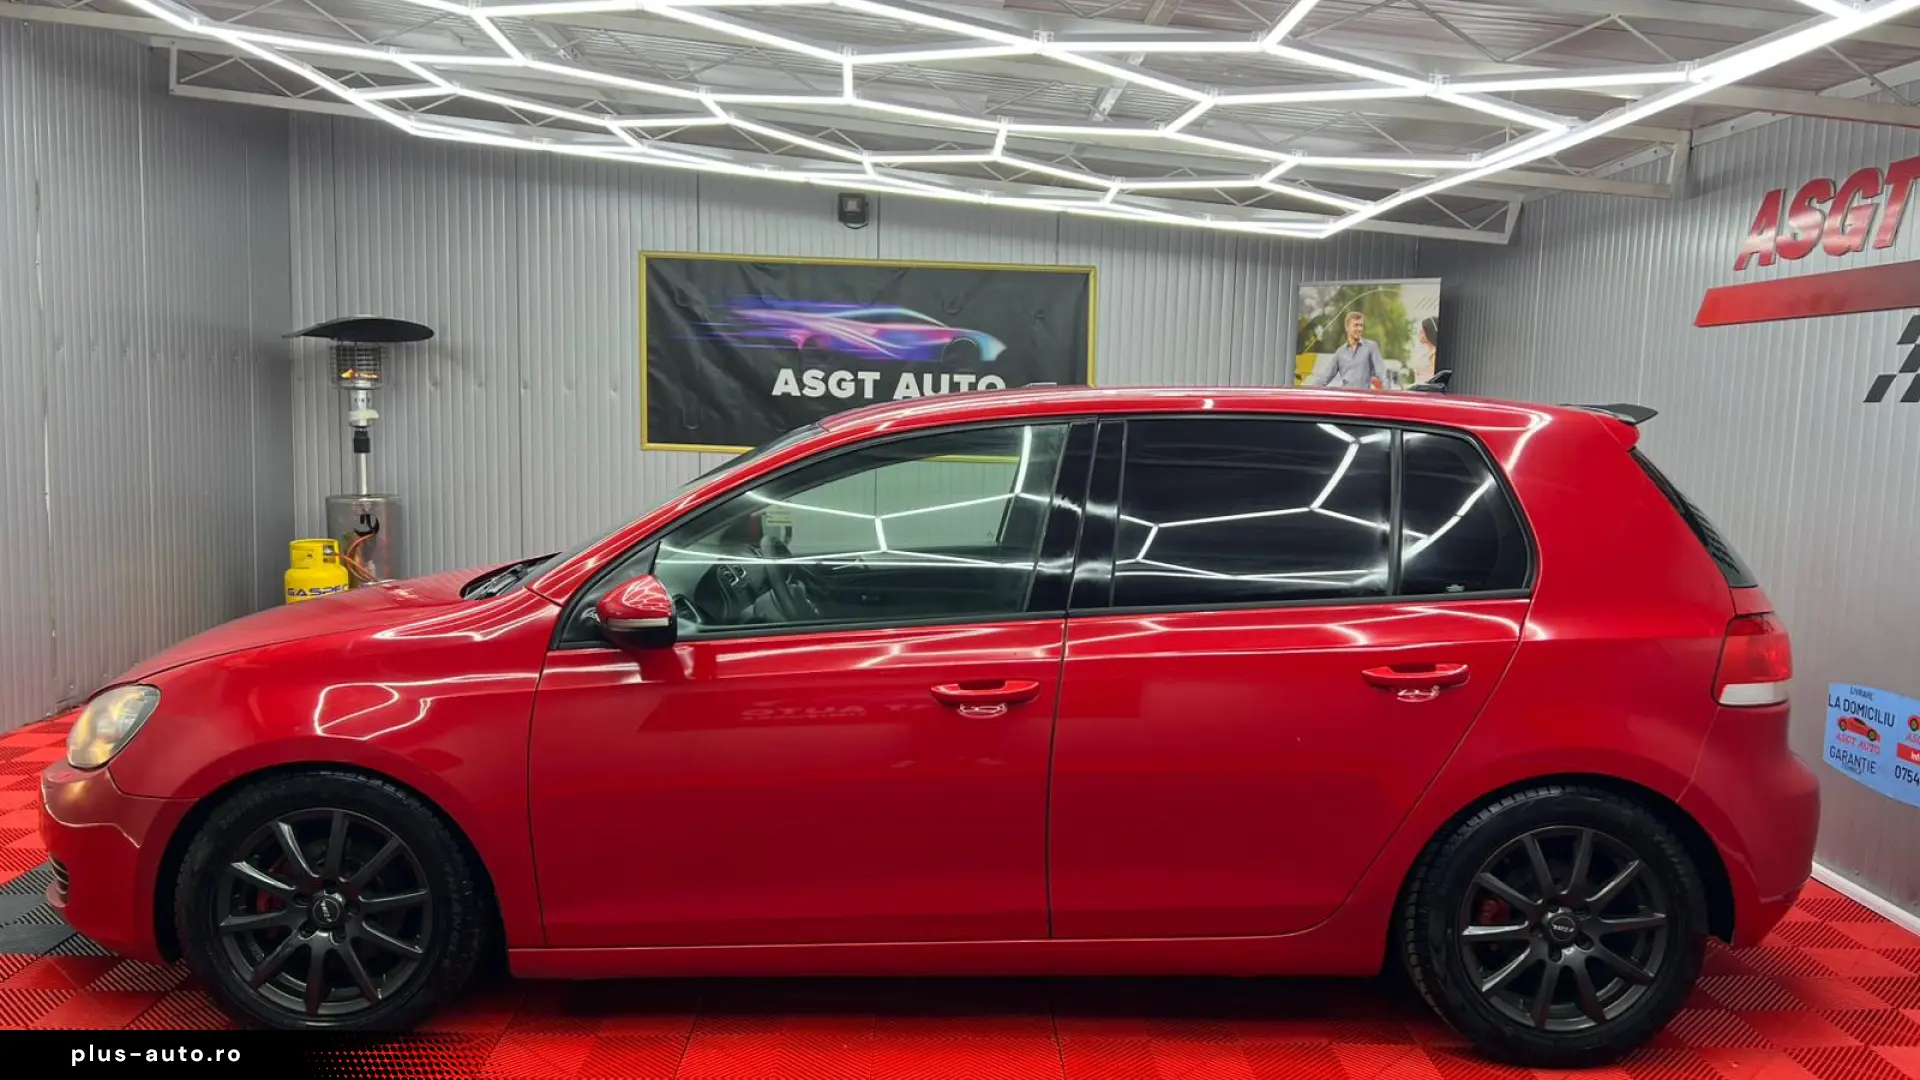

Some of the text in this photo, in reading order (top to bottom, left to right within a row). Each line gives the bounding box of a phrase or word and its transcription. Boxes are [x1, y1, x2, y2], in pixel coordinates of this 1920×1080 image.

[1733, 156, 1920, 271] ASGT
[772, 368, 881, 399] ASGT
[1828, 694, 1895, 727] LA DOMICILIU
[1829, 746, 1877, 774] GARANTIE
